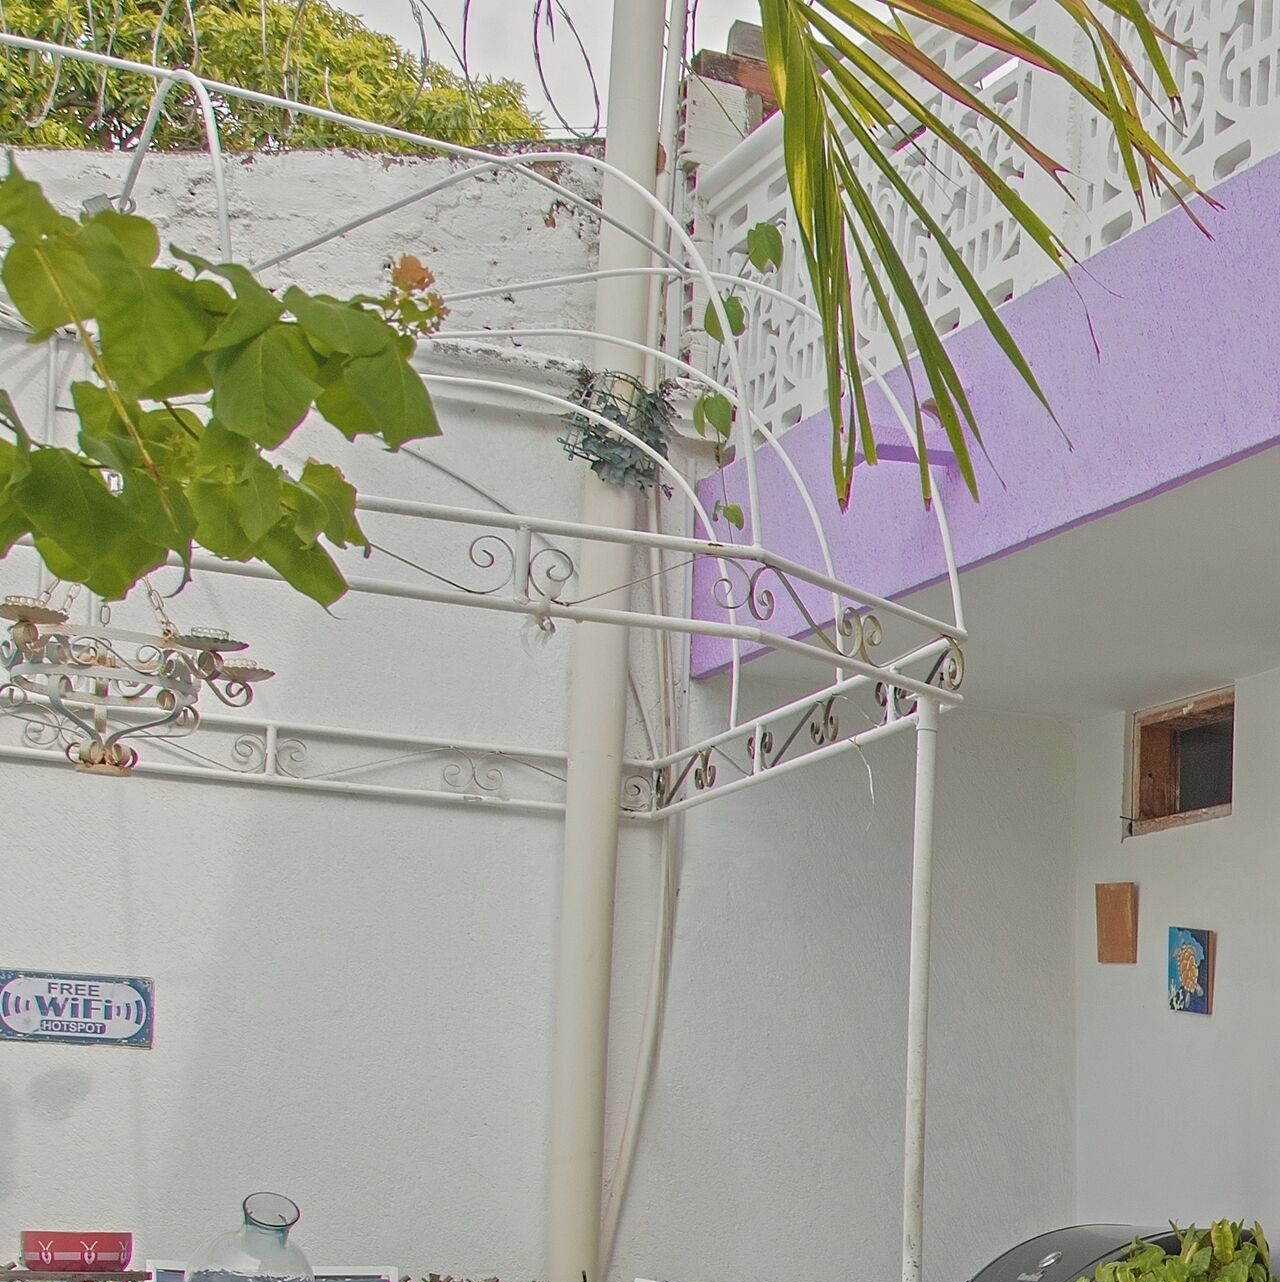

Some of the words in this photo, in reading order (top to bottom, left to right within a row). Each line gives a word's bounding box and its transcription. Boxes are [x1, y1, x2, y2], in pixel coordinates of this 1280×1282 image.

[48, 982, 100, 996] FREE
[34, 995, 113, 1020] WiFi
[41, 1021, 103, 1033] HOTSPOT
